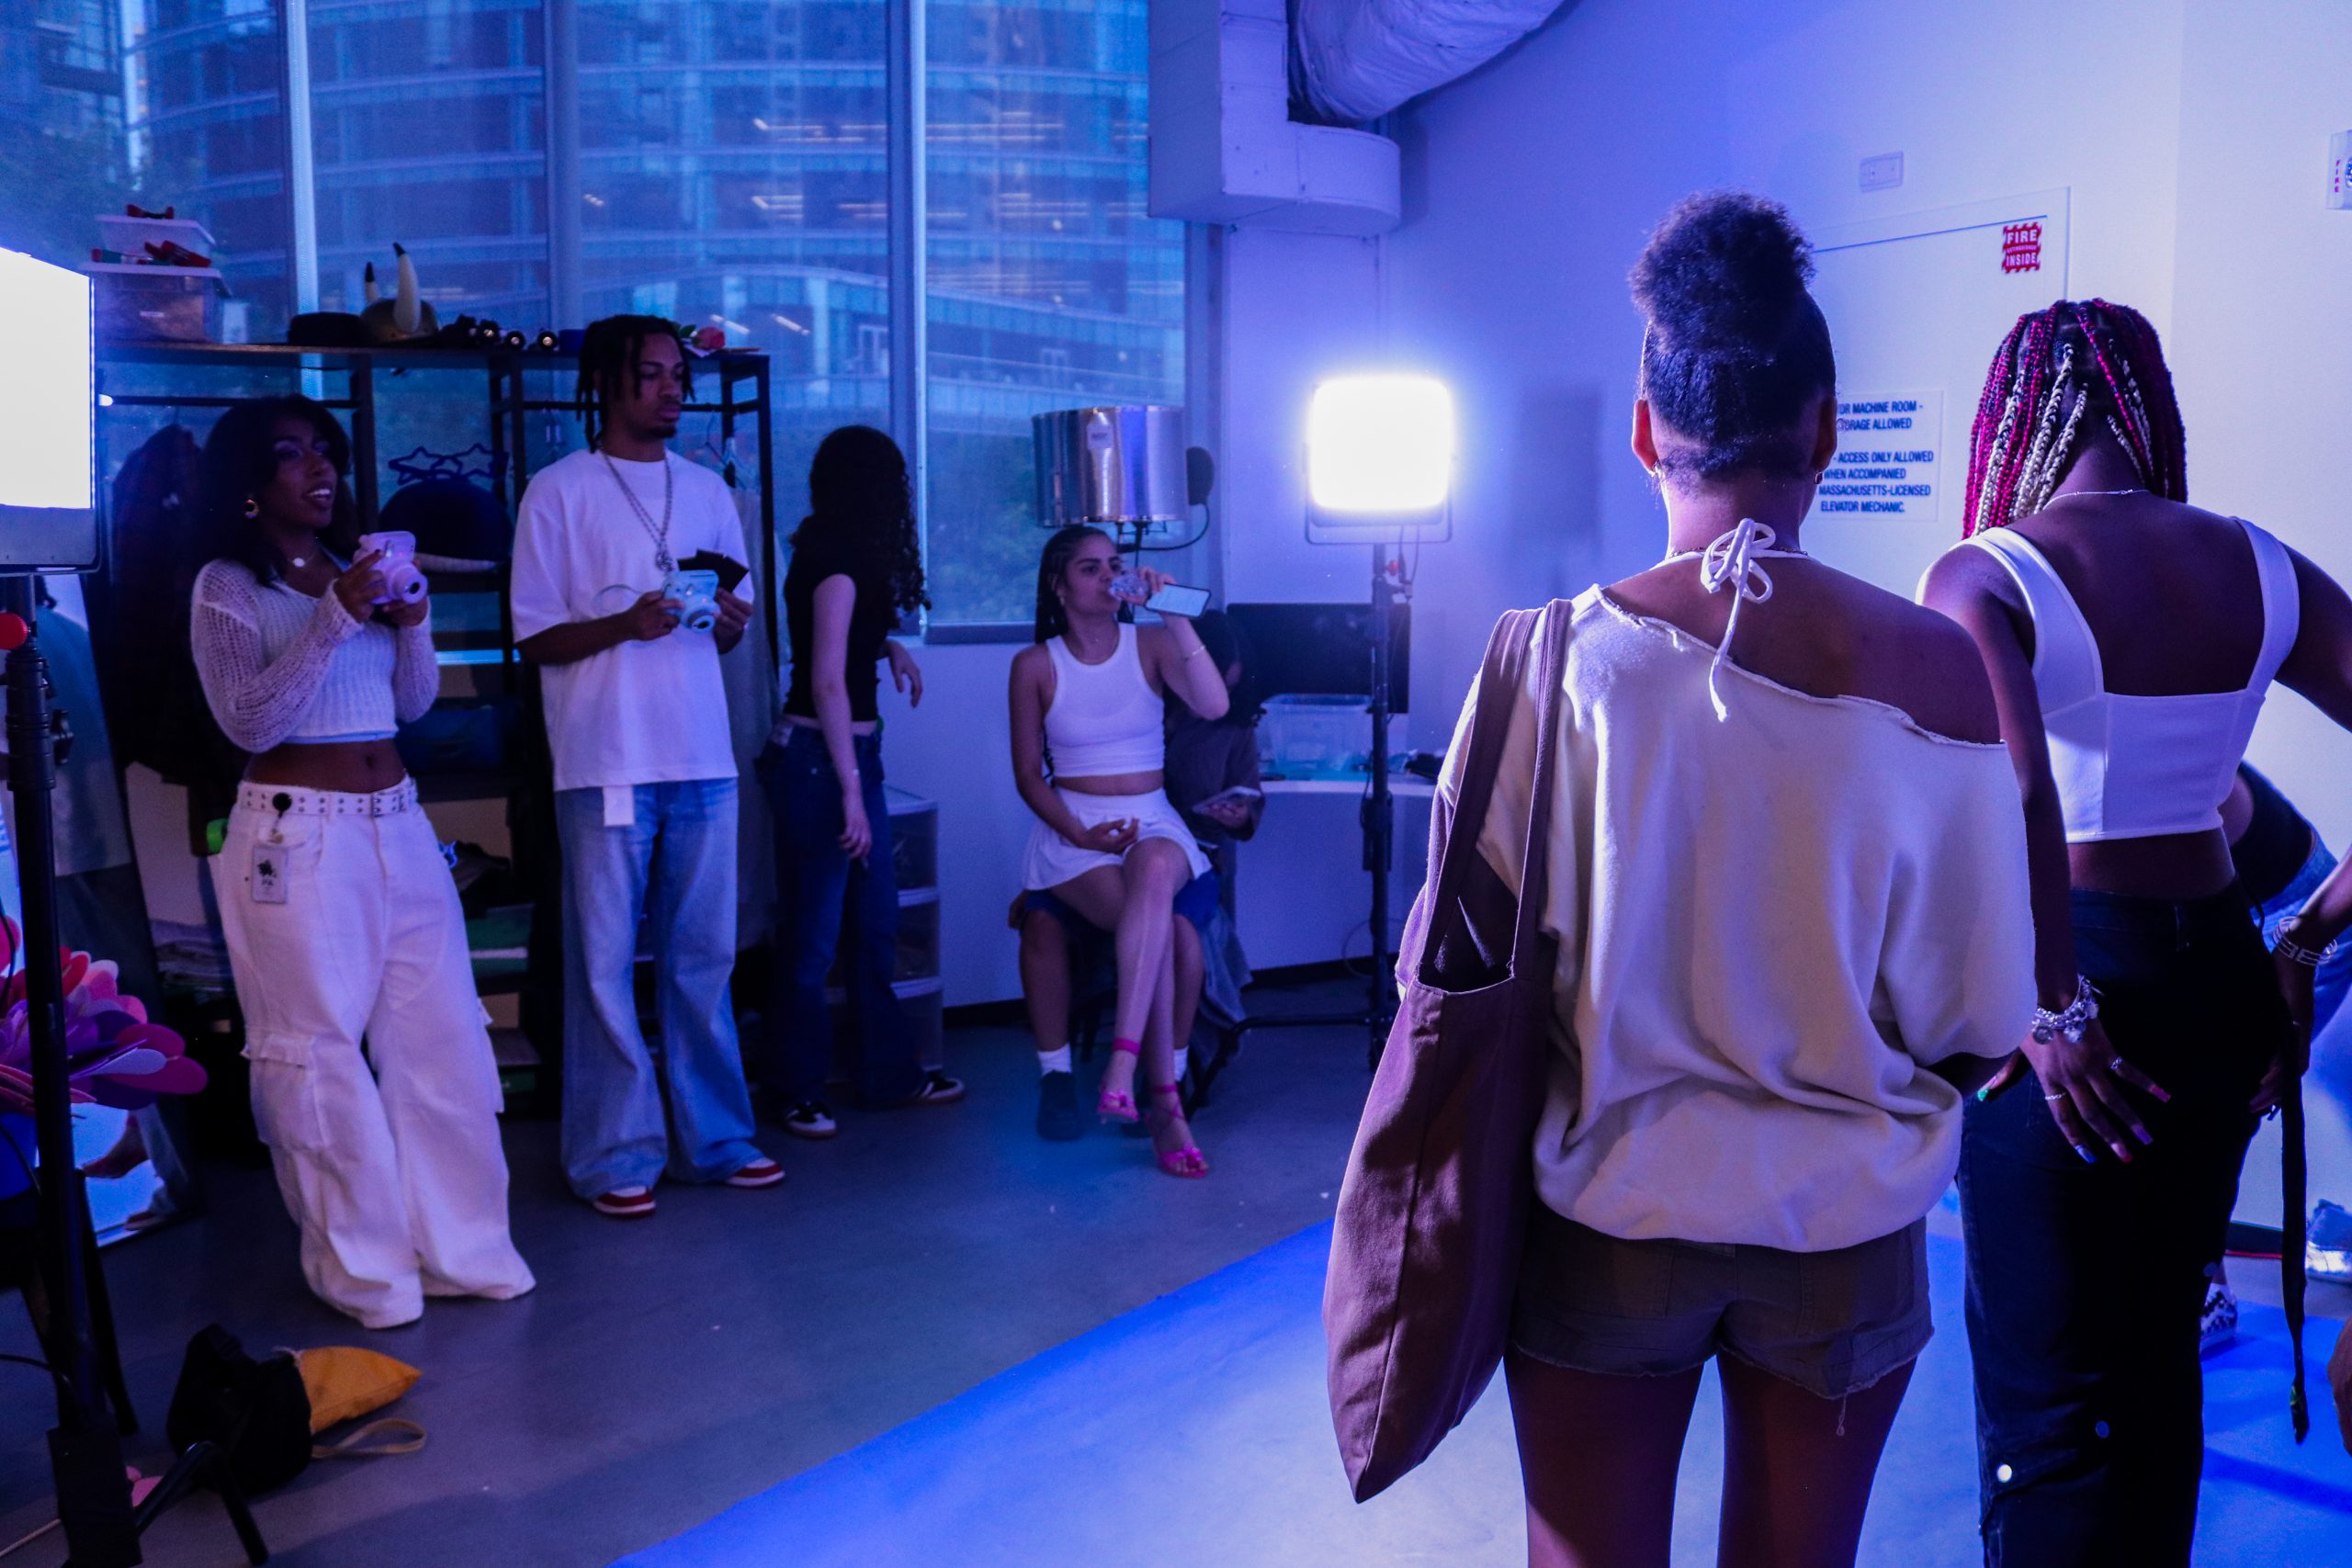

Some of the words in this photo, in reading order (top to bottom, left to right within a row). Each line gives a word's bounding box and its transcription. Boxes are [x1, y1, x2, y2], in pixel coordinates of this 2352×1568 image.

[2007, 229, 2038, 244] FIRE
[2006, 252, 2037, 267] INSIDE
[1852, 401, 1889, 414] MACHINE
[1891, 400, 1917, 412] ROOM
[1872, 418, 1912, 430] ALLOWED
[1838, 451, 1869, 463] ACCESS
[1871, 451, 1892, 463] ONLY
[1893, 450, 1934, 462] ALLOWED
[1824, 468, 1847, 479] WHEN
[1848, 468, 1906, 479] ACCOMPANIED
[1818, 484, 1931, 496] MASSACHUSETTS-LICENSED
[1821, 501, 1860, 512] ELEVATOR
[1860, 501, 1905, 513] MECHANIC.
